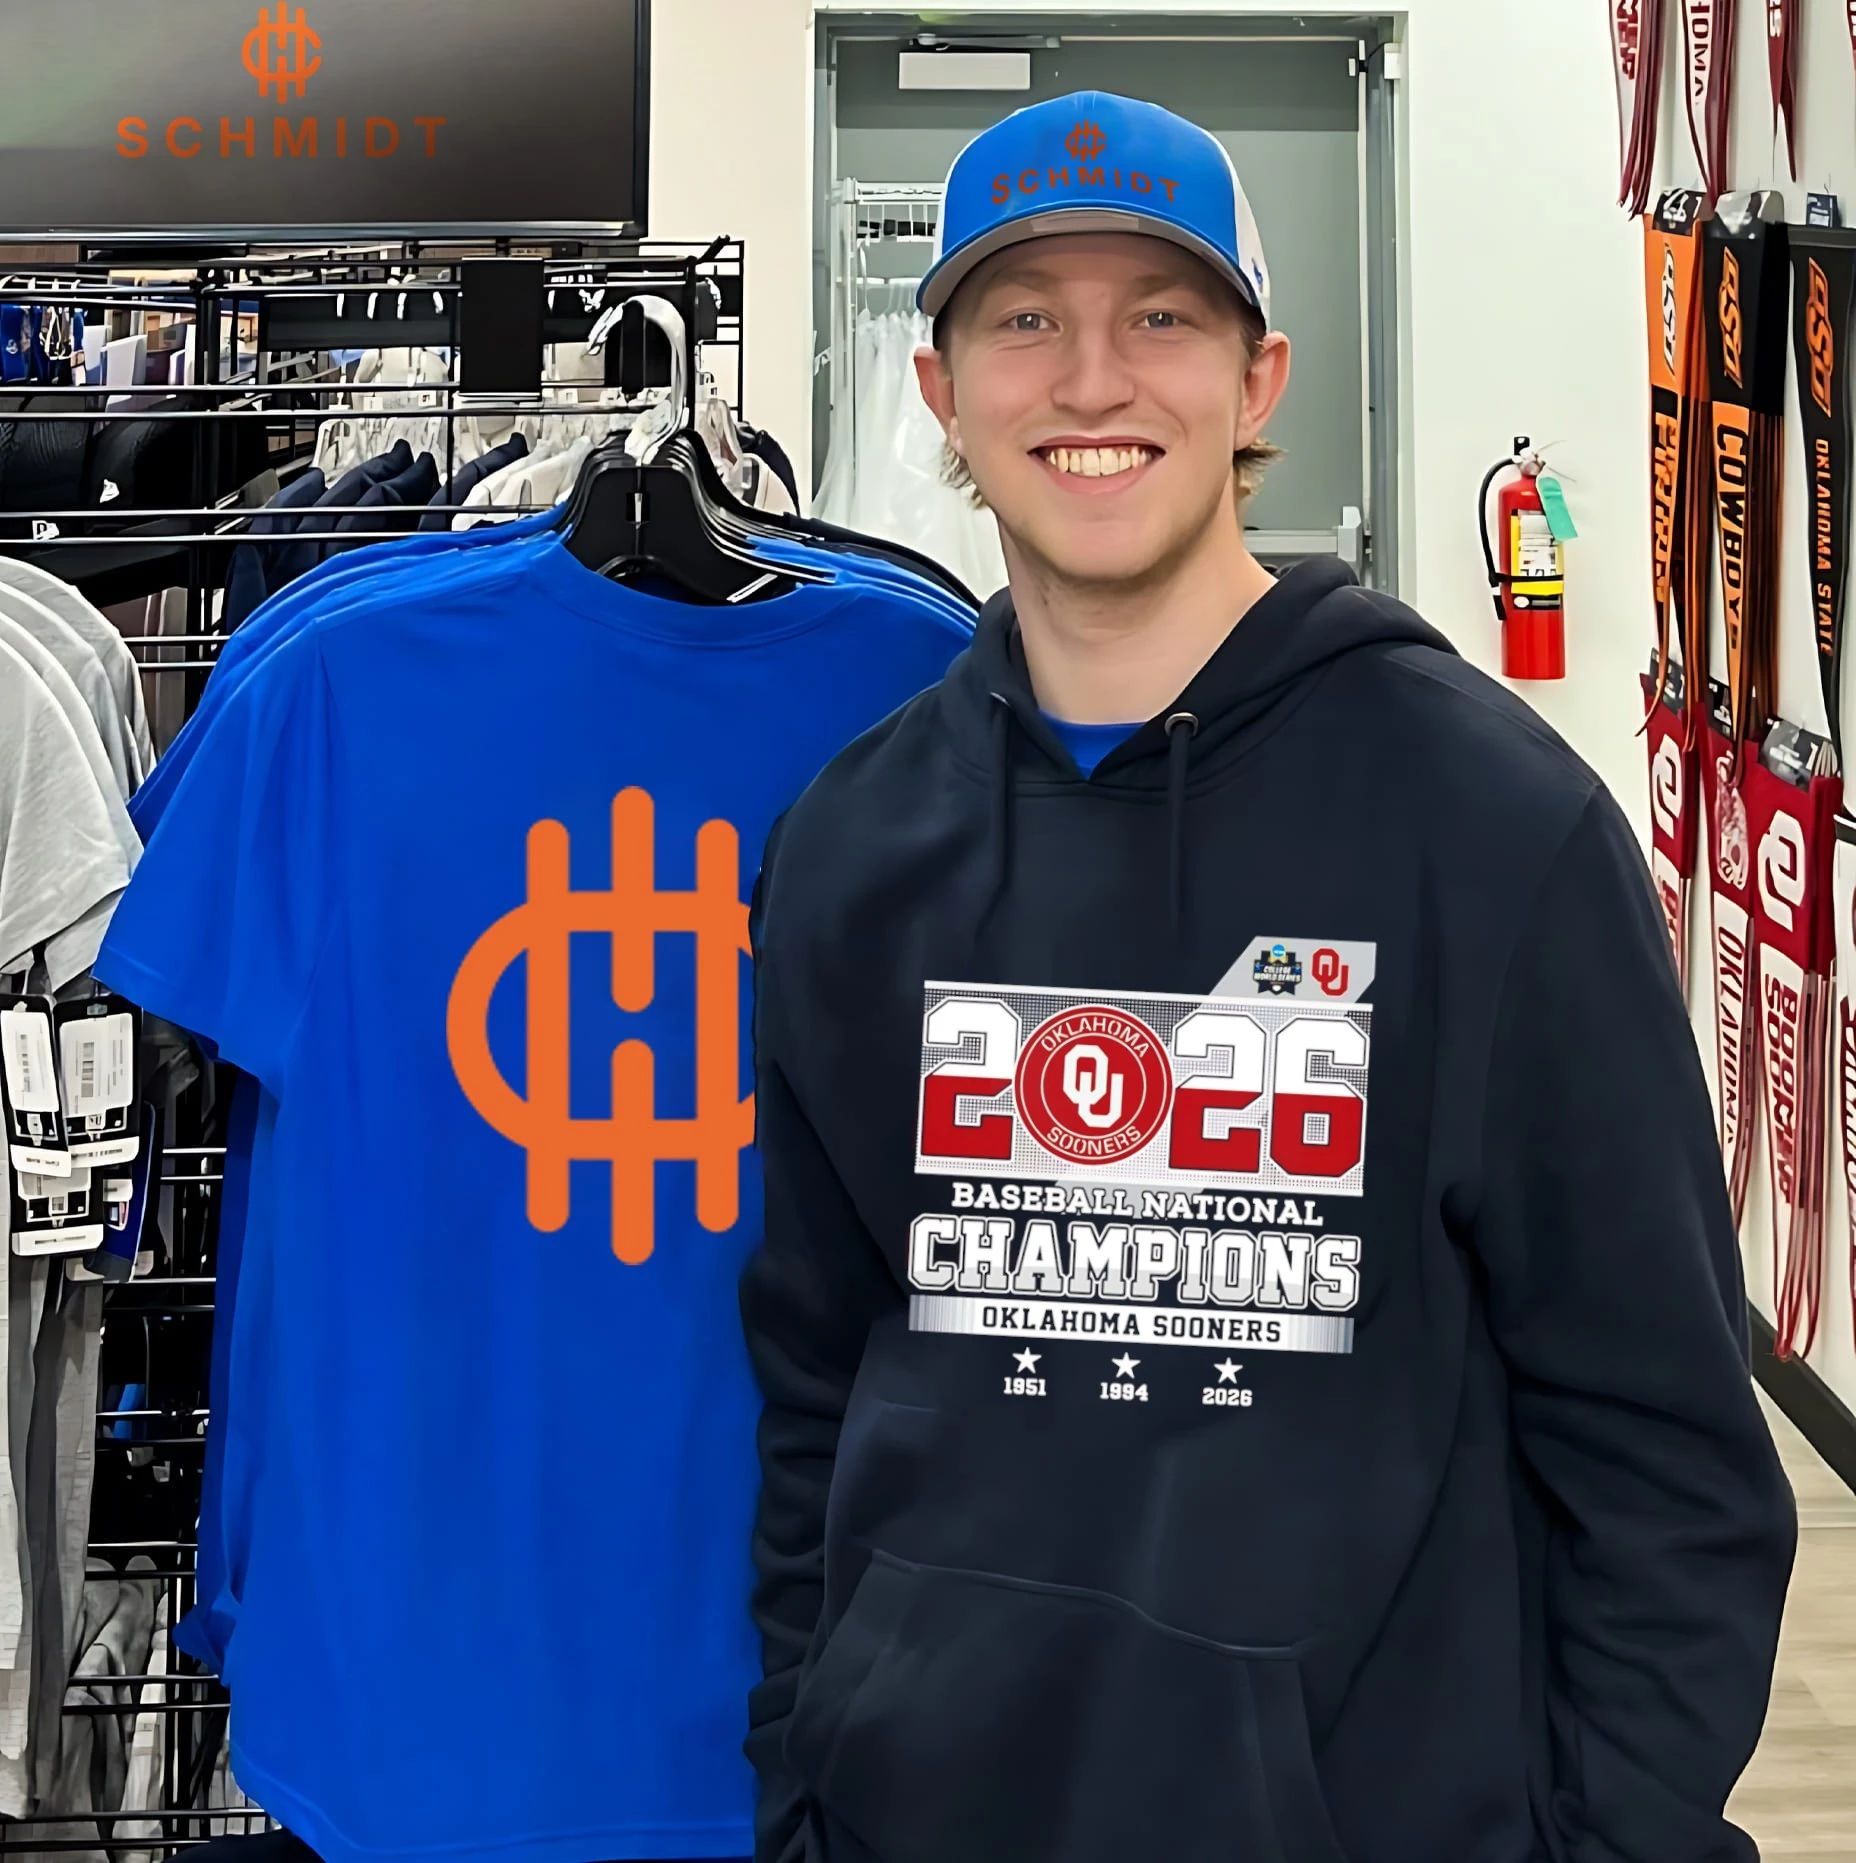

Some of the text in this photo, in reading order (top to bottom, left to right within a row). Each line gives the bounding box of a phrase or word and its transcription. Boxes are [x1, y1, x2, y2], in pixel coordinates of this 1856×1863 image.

[116, 116, 448, 159] SCHMIDT
[991, 166, 1181, 204] SCHMIDT
[1815, 438, 1833, 570] OKLAHOMA
[1757, 809, 1806, 932] OU
[1311, 948, 1349, 997] OU
[1040, 1015, 1151, 1058] OKLAHOMA
[1717, 926, 1746, 1144] OKLAHOMA
[1061, 1043, 1124, 1128] OU
[1046, 1124, 1143, 1157] SOONERS
[951, 1181, 1324, 1227] BASEBALL NATIONAL
[907, 1212, 1362, 1311] CHAMPIONS
[982, 1305, 1282, 1343] OKLAHOMA SOONERS
[1003, 1377, 1253, 1407] 1951 1994 2026
